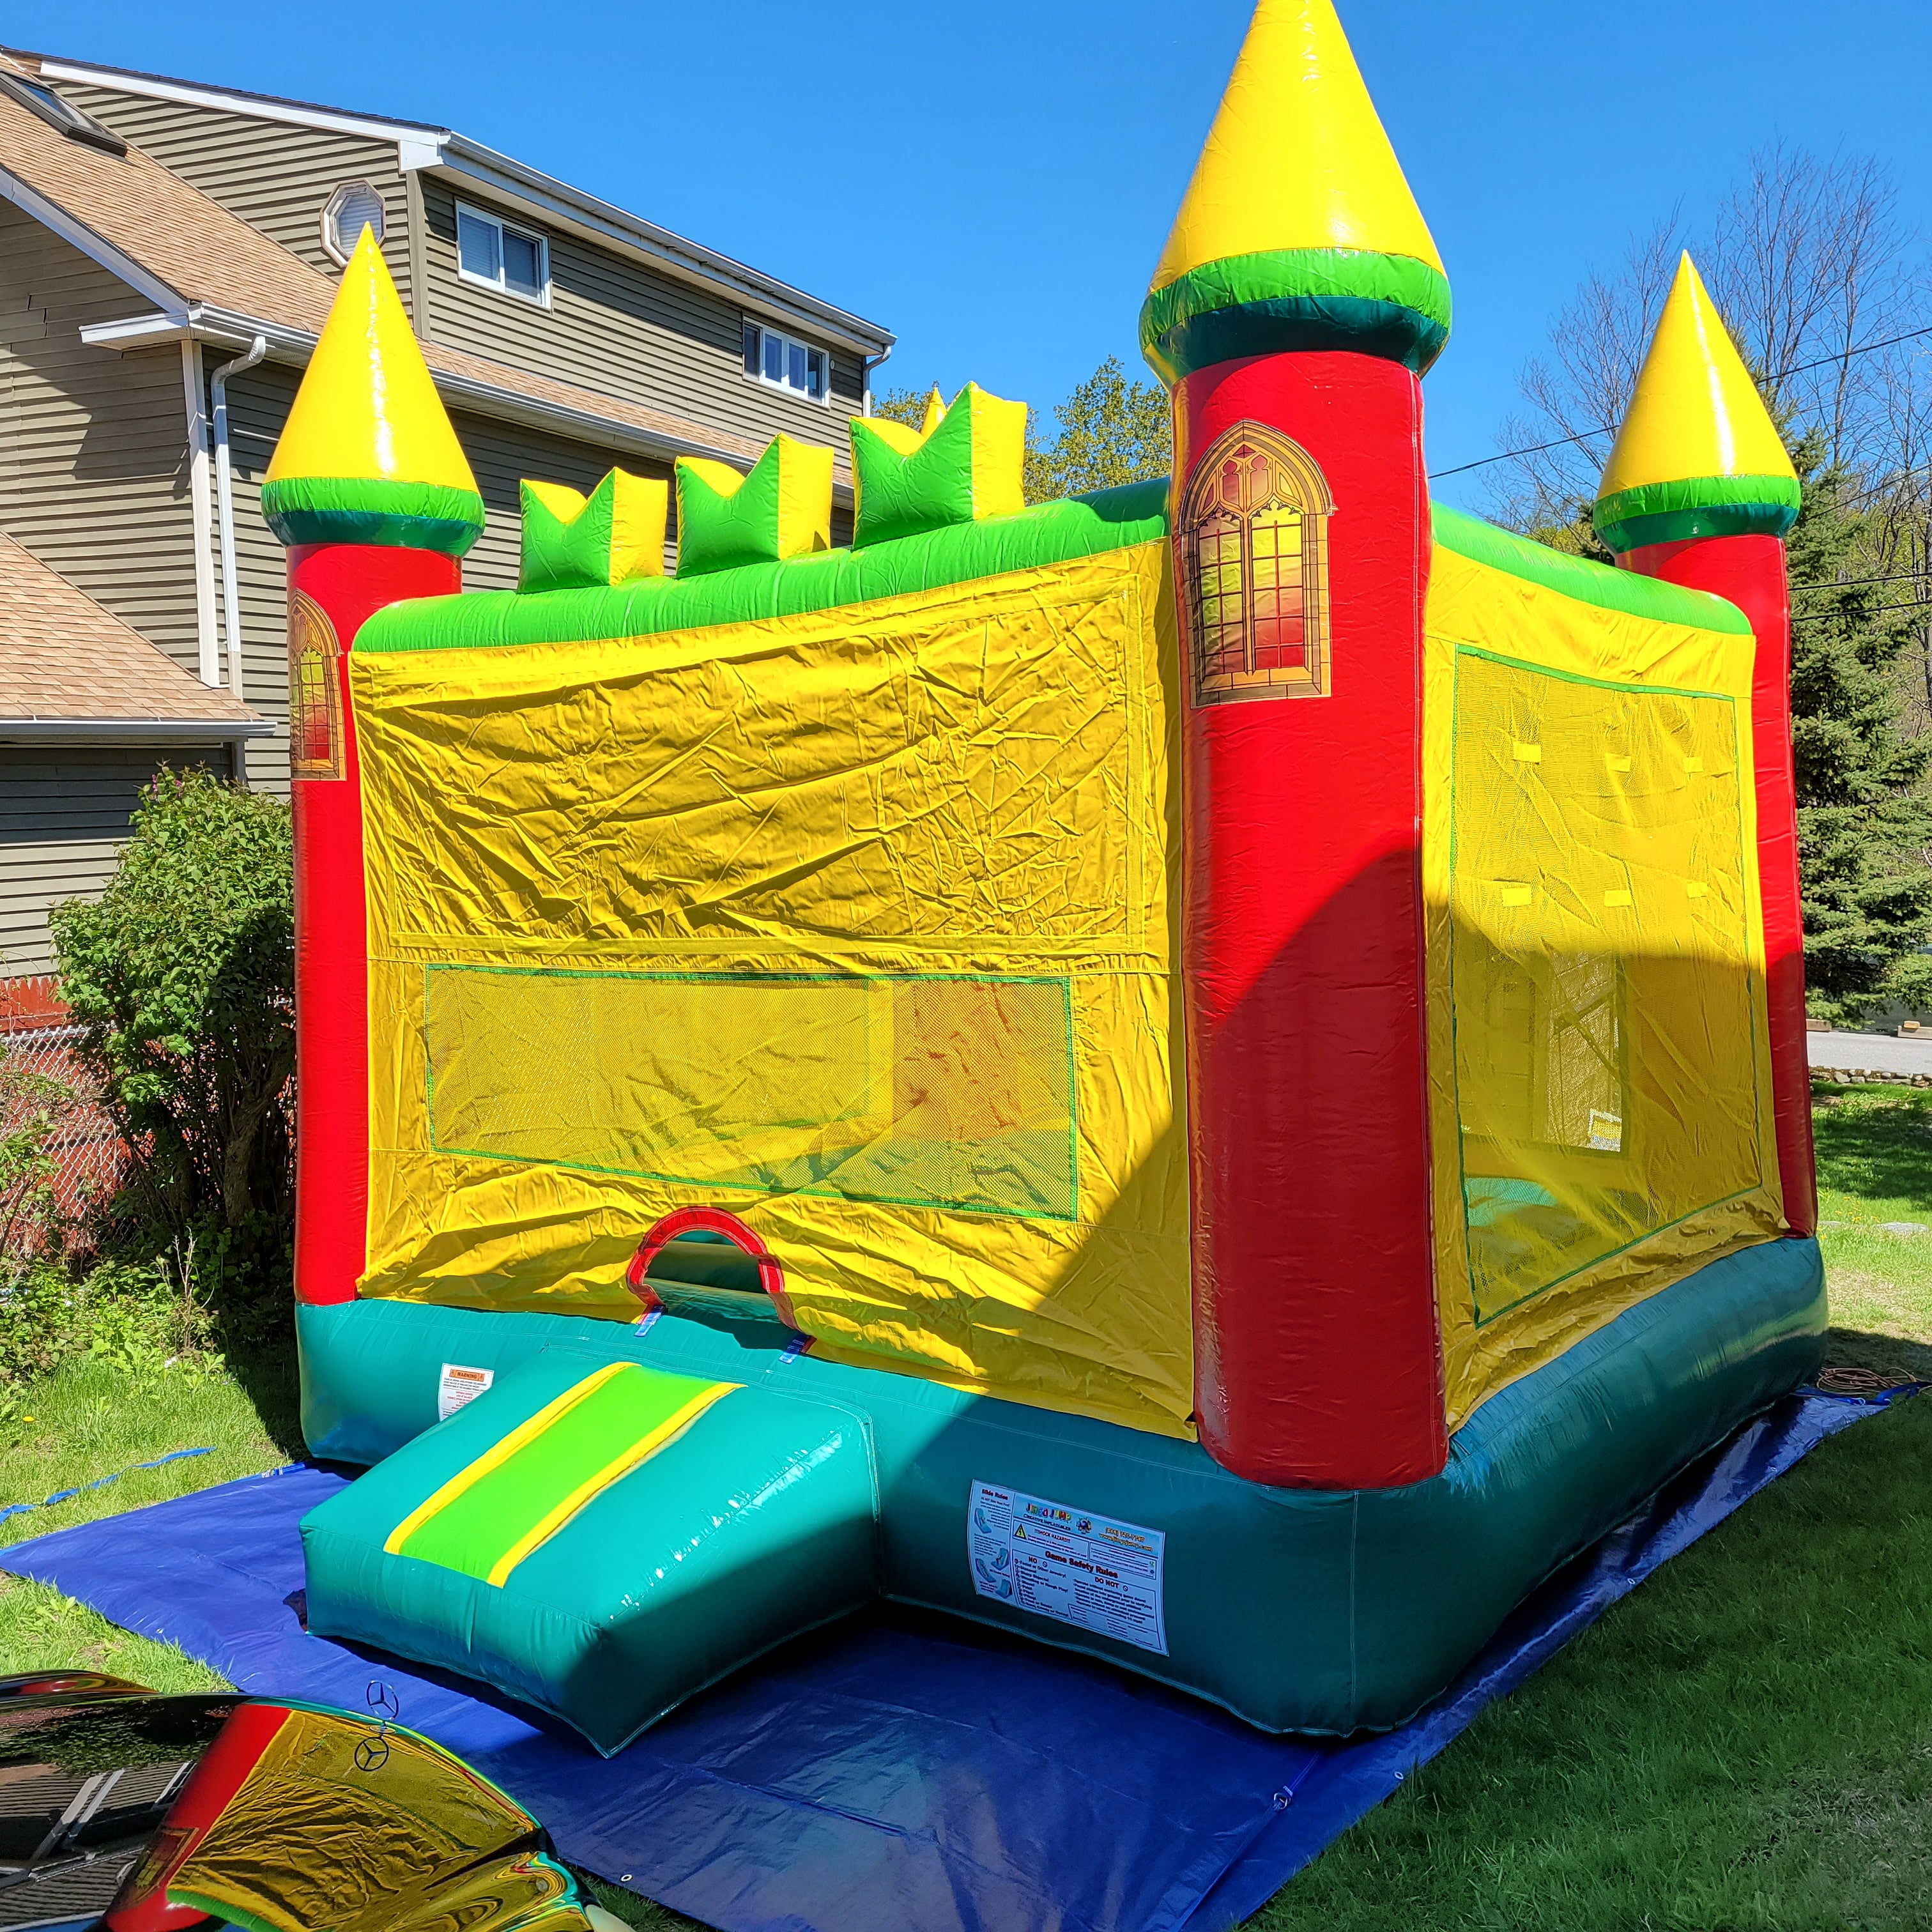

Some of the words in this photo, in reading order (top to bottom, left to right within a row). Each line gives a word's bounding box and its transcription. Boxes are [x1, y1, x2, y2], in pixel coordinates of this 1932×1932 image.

[1028, 1556, 1038, 1564] NO
[1045, 1551, 1067, 1563] Game
[1069, 1558, 1094, 1573] Safety
[1096, 1565, 1118, 1579] Rules
[1105, 1579, 1119, 1589] NOT
